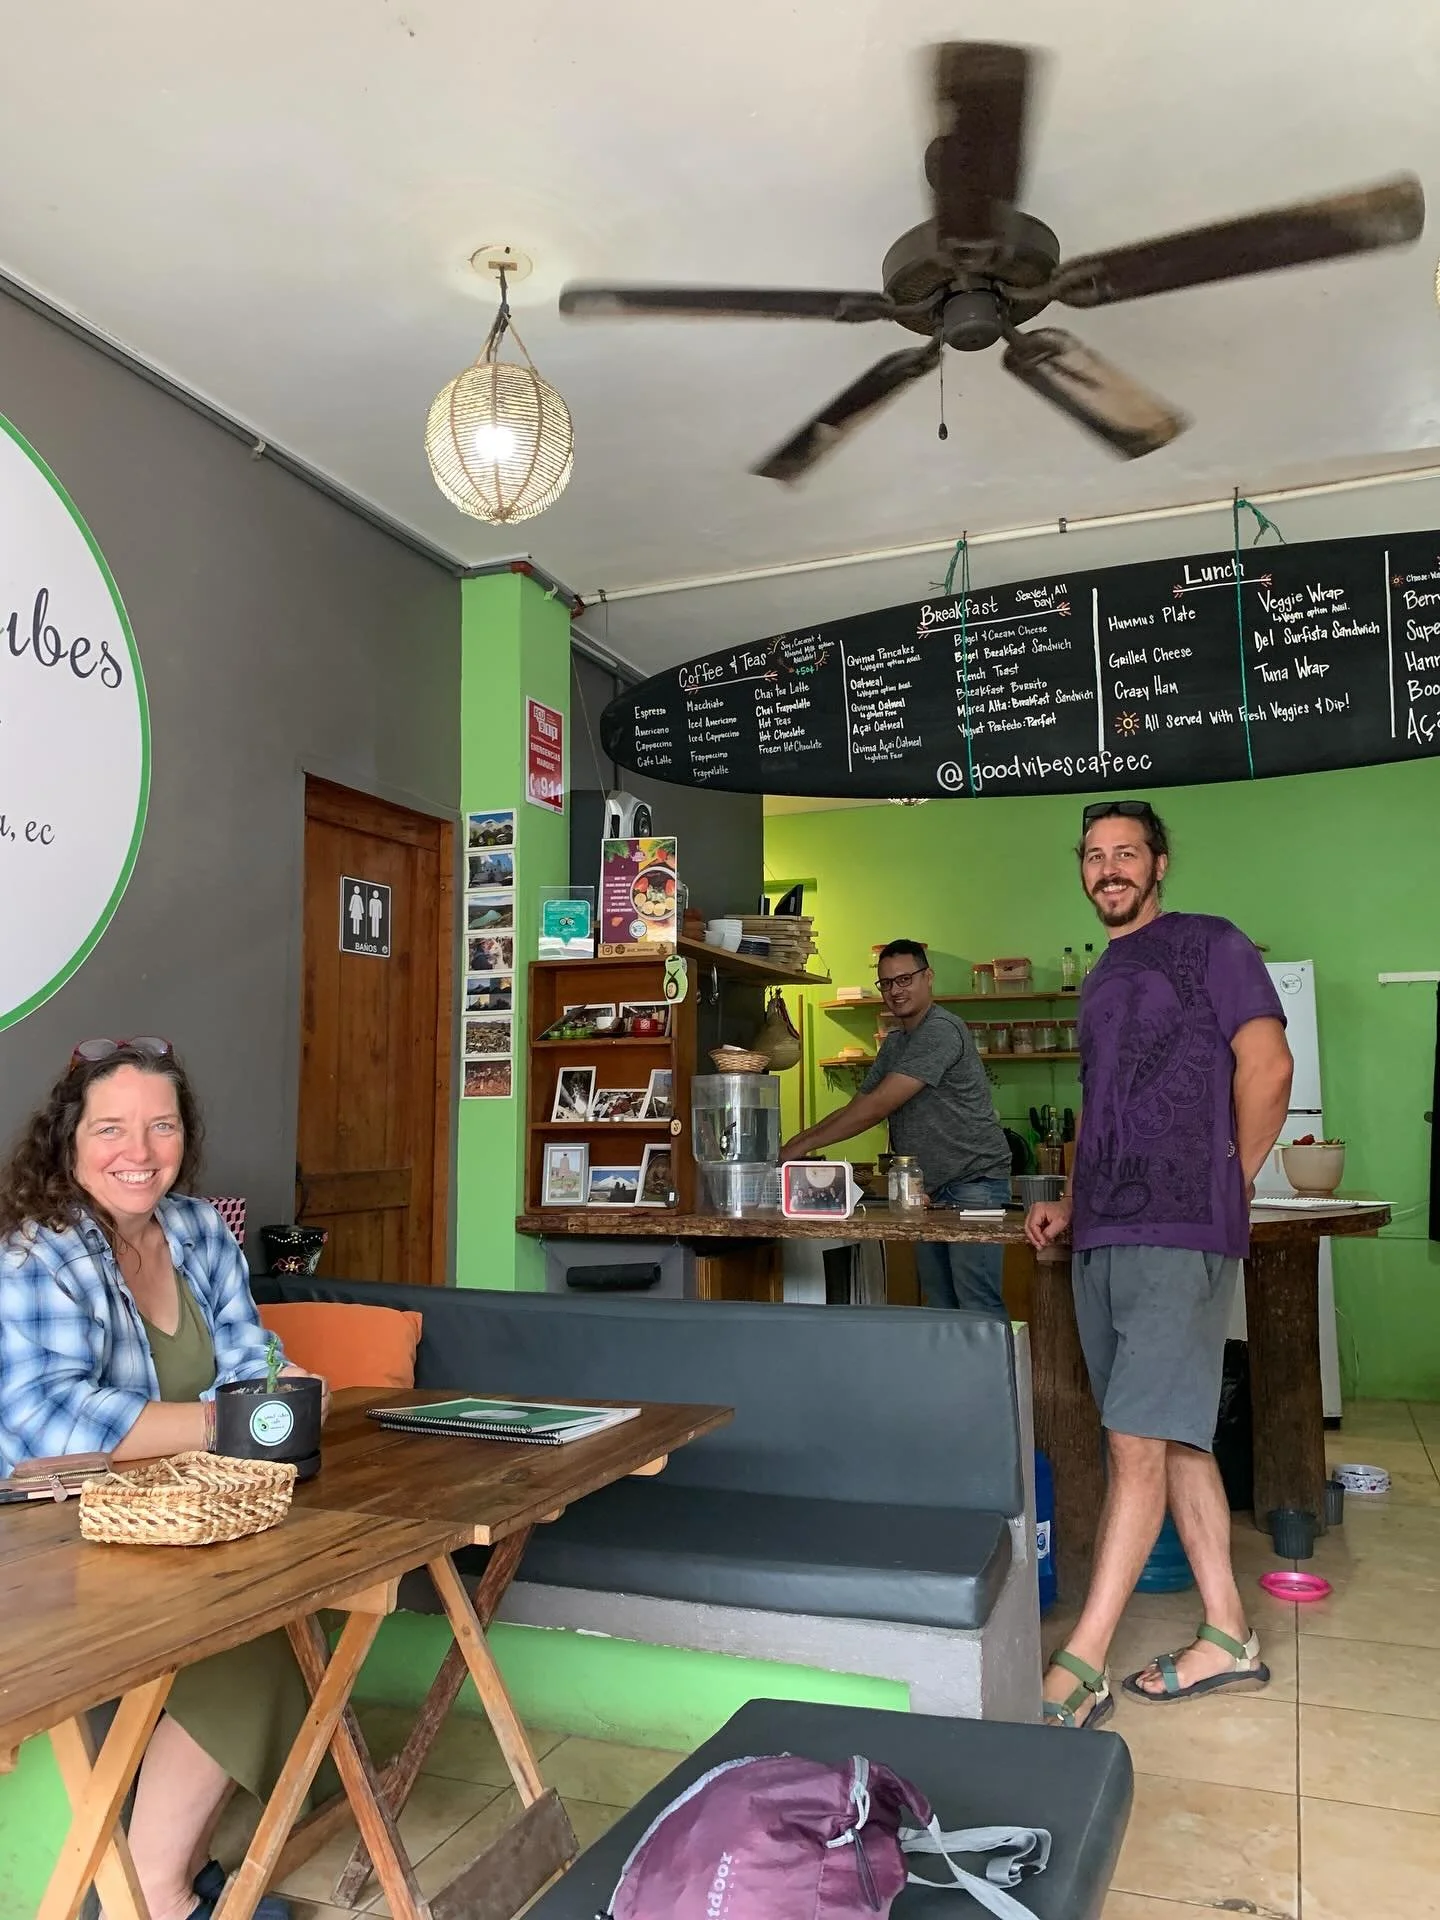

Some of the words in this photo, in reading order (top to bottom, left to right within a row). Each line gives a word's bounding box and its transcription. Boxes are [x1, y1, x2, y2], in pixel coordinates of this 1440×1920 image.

[1183, 557, 1245, 585] Lunch
[1015, 586, 1047, 602] Served
[1054, 583, 1068, 595] All
[1033, 593, 1055, 608] Day!
[1257, 589, 1304, 613] Veggie
[1306, 583, 1344, 603] Wrap
[1403, 589, 1440, 610] Berr
[920, 595, 999, 627] Breakfast
[1107, 614, 1155, 632] Hummus
[1161, 605, 1196, 623] Plate
[1306, 606, 1328, 618] option
[0, 587, 123, 688] ibes
[988, 629, 1015, 641] Cream
[1018, 625, 1048, 636] Cheese
[1254, 628, 1274, 653] Del
[1284, 624, 1328, 645] Surfista
[1332, 619, 1380, 639] Sandwich
[877, 644, 915, 660] Pancakes
[984, 642, 1026, 659] Breakfast
[1032, 637, 1072, 654] Sandwich
[1108, 648, 1148, 669] Grilled
[1153, 647, 1193, 663] Cheese
[679, 662, 724, 688] Coffee
[729, 655, 738, 674] &
[739, 652, 767, 671] Teas
[992, 663, 1019, 677] Toast
[1254, 662, 1289, 683] Tuna
[1294, 655, 1330, 679] Wrap
[754, 688, 773, 701] Chai
[789, 681, 810, 695] Latte
[850, 675, 883, 690] Oatmeal
[1010, 677, 1047, 693] Burrito
[1114, 680, 1150, 701] Crazy
[1153, 674, 1179, 696] Ham
[1406, 679, 1440, 702] Boo
[686, 698, 724, 712] Macchiato
[878, 697, 906, 711] Oatmeal
[1011, 692, 1050, 708] Breakfast
[1055, 688, 1094, 704] Sandwich
[634, 706, 666, 720] Espresso
[755, 705, 773, 718] Chai
[1025, 712, 1057, 728] Parfait
[1145, 713, 1160, 732] All
[1166, 710, 1202, 729] Served
[1209, 708, 1234, 725] With
[1269, 700, 1310, 723] Veggies
[1324, 692, 1351, 713] Dip!
[635, 725, 670, 737] Americano
[688, 717, 703, 729] Iced
[705, 716, 737, 728] Americano
[758, 717, 771, 729] Hot
[774, 717, 791, 726] Teas
[852, 723, 871, 737] Açai
[874, 717, 904, 732] Oatmeal
[688, 733, 703, 743] Iced
[758, 730, 771, 742] Hot
[774, 725, 806, 741] Chocolate
[896, 735, 922, 749] Oatmeal
[758, 744, 782, 755] Frozen
[794, 739, 823, 752] Chocolate
[637, 755, 654, 768] Cafe
[655, 754, 673, 766] Latte
[541, 776, 562, 803] 911
[25, 820, 56, 845] ec
[354, 941, 378, 953] BAÑOS
[706, 1851, 733, 1920] tdoor
